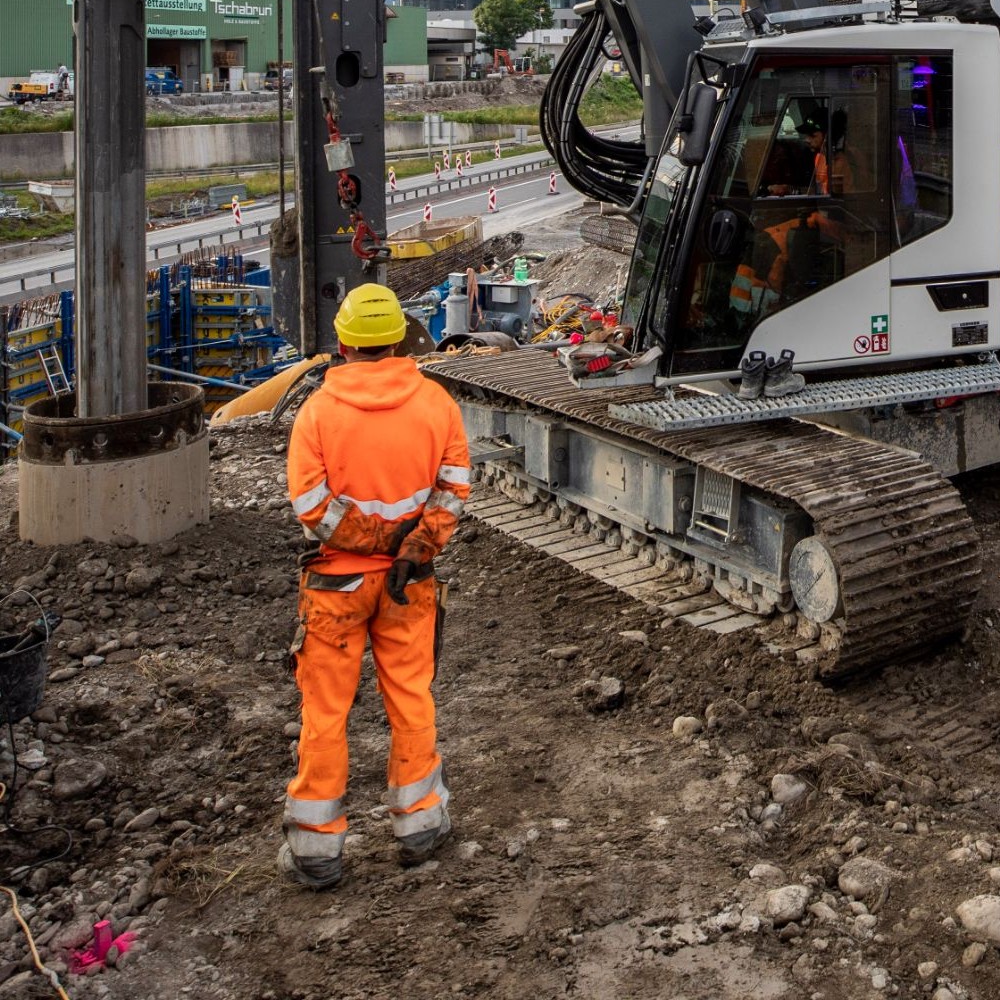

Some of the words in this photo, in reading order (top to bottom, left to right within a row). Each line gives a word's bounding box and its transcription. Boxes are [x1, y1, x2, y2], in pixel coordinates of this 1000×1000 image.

[210, 0, 272, 16] Tschabrun
[147, 26, 178, 36] Abhollager
[180, 28, 207, 36] Baustoffe
